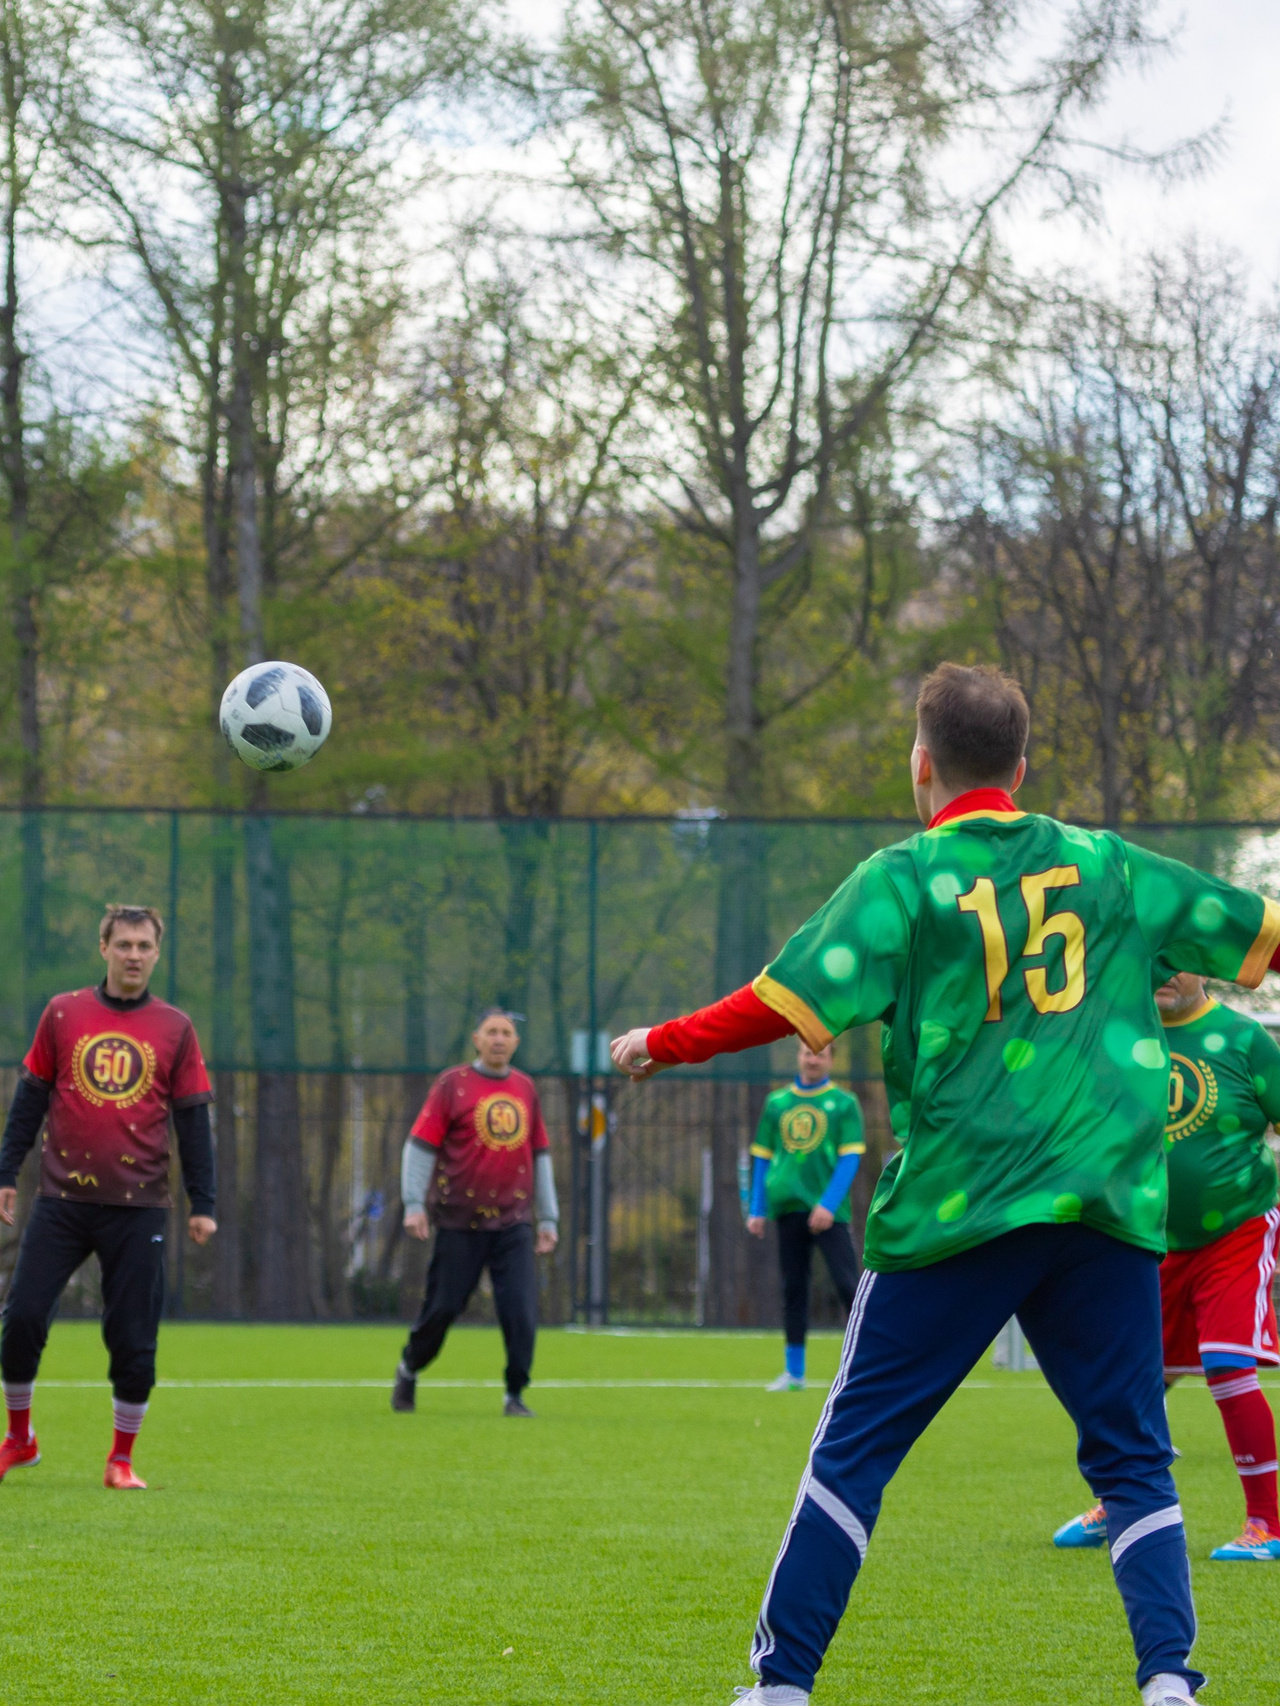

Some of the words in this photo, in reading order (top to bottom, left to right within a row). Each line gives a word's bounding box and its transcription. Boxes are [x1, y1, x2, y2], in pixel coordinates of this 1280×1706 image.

[956, 864, 1086, 1023] 15
[93, 1048, 132, 1085] 50
[490, 1105, 516, 1133] 50
